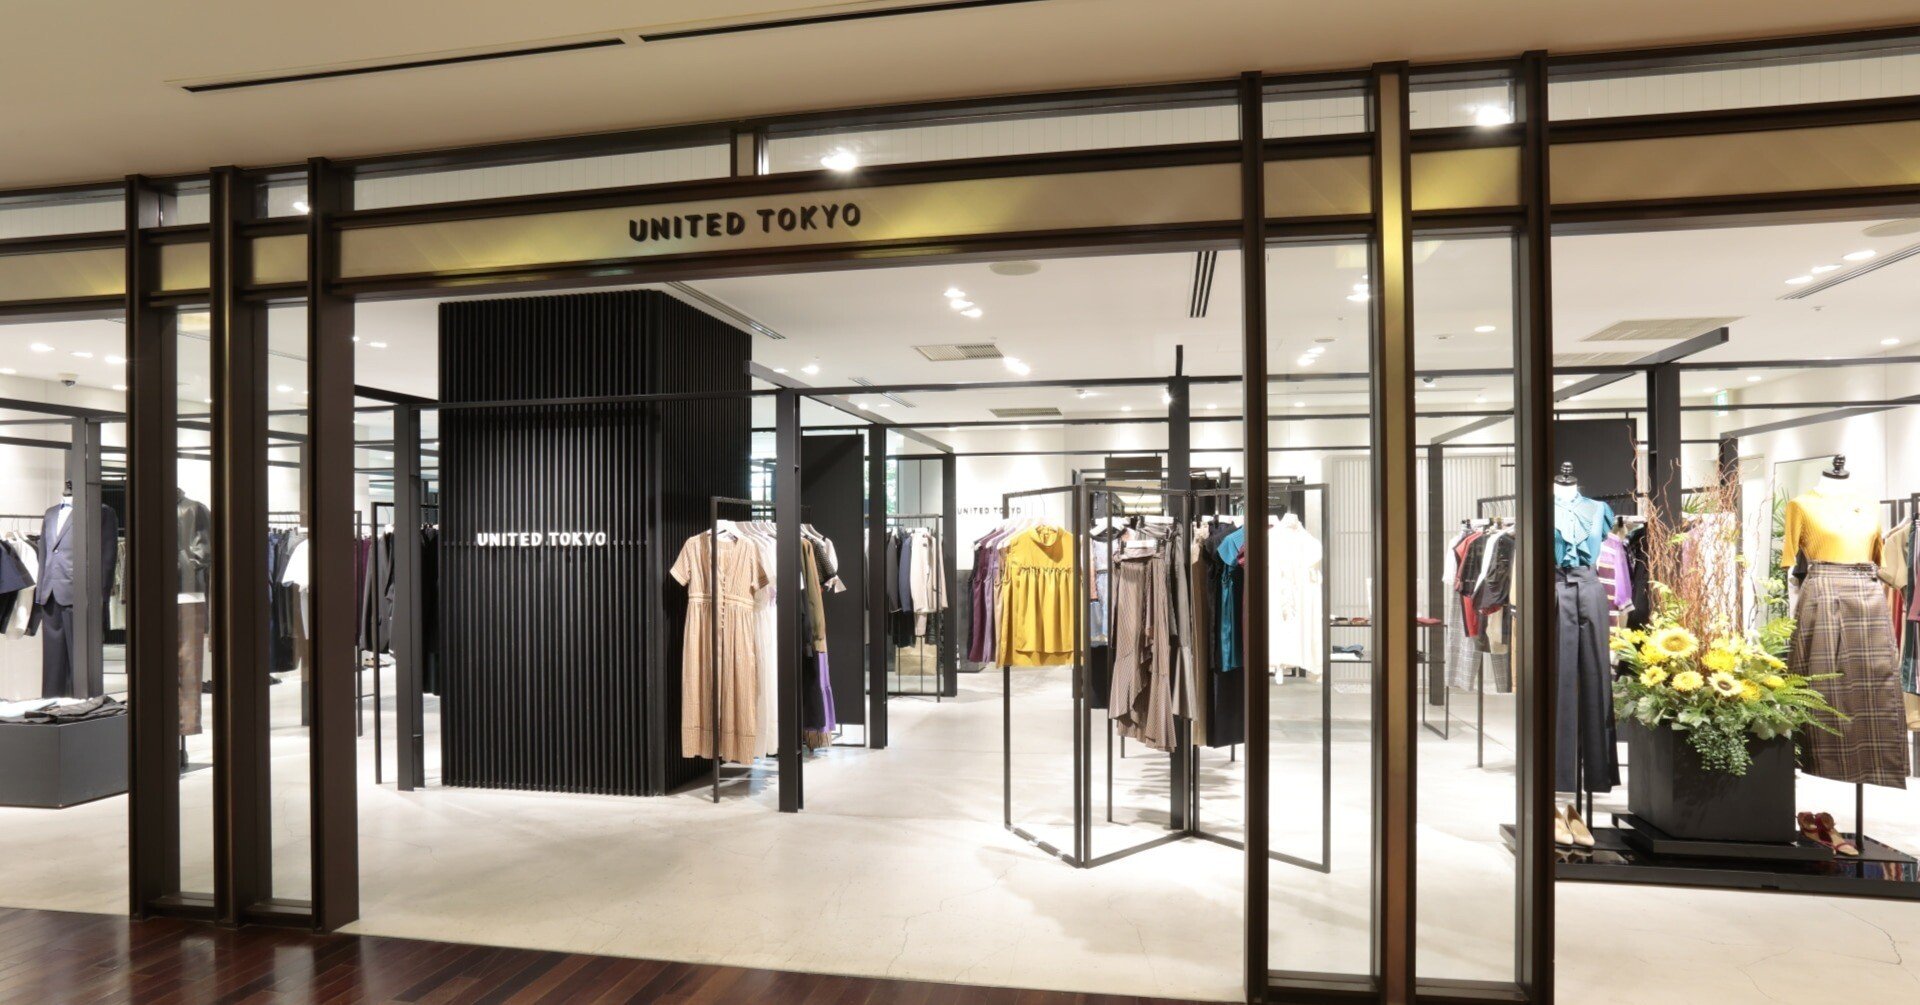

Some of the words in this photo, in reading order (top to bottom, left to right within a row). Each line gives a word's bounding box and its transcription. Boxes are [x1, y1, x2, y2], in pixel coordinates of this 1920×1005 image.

[629, 212, 745, 242] UNITED
[756, 202, 861, 233] TOKYO
[957, 507, 989, 515] UNITED
[993, 507, 1021, 515] TOYO
[477, 532, 542, 547] UNITED
[548, 531, 607, 547] TOKYO
